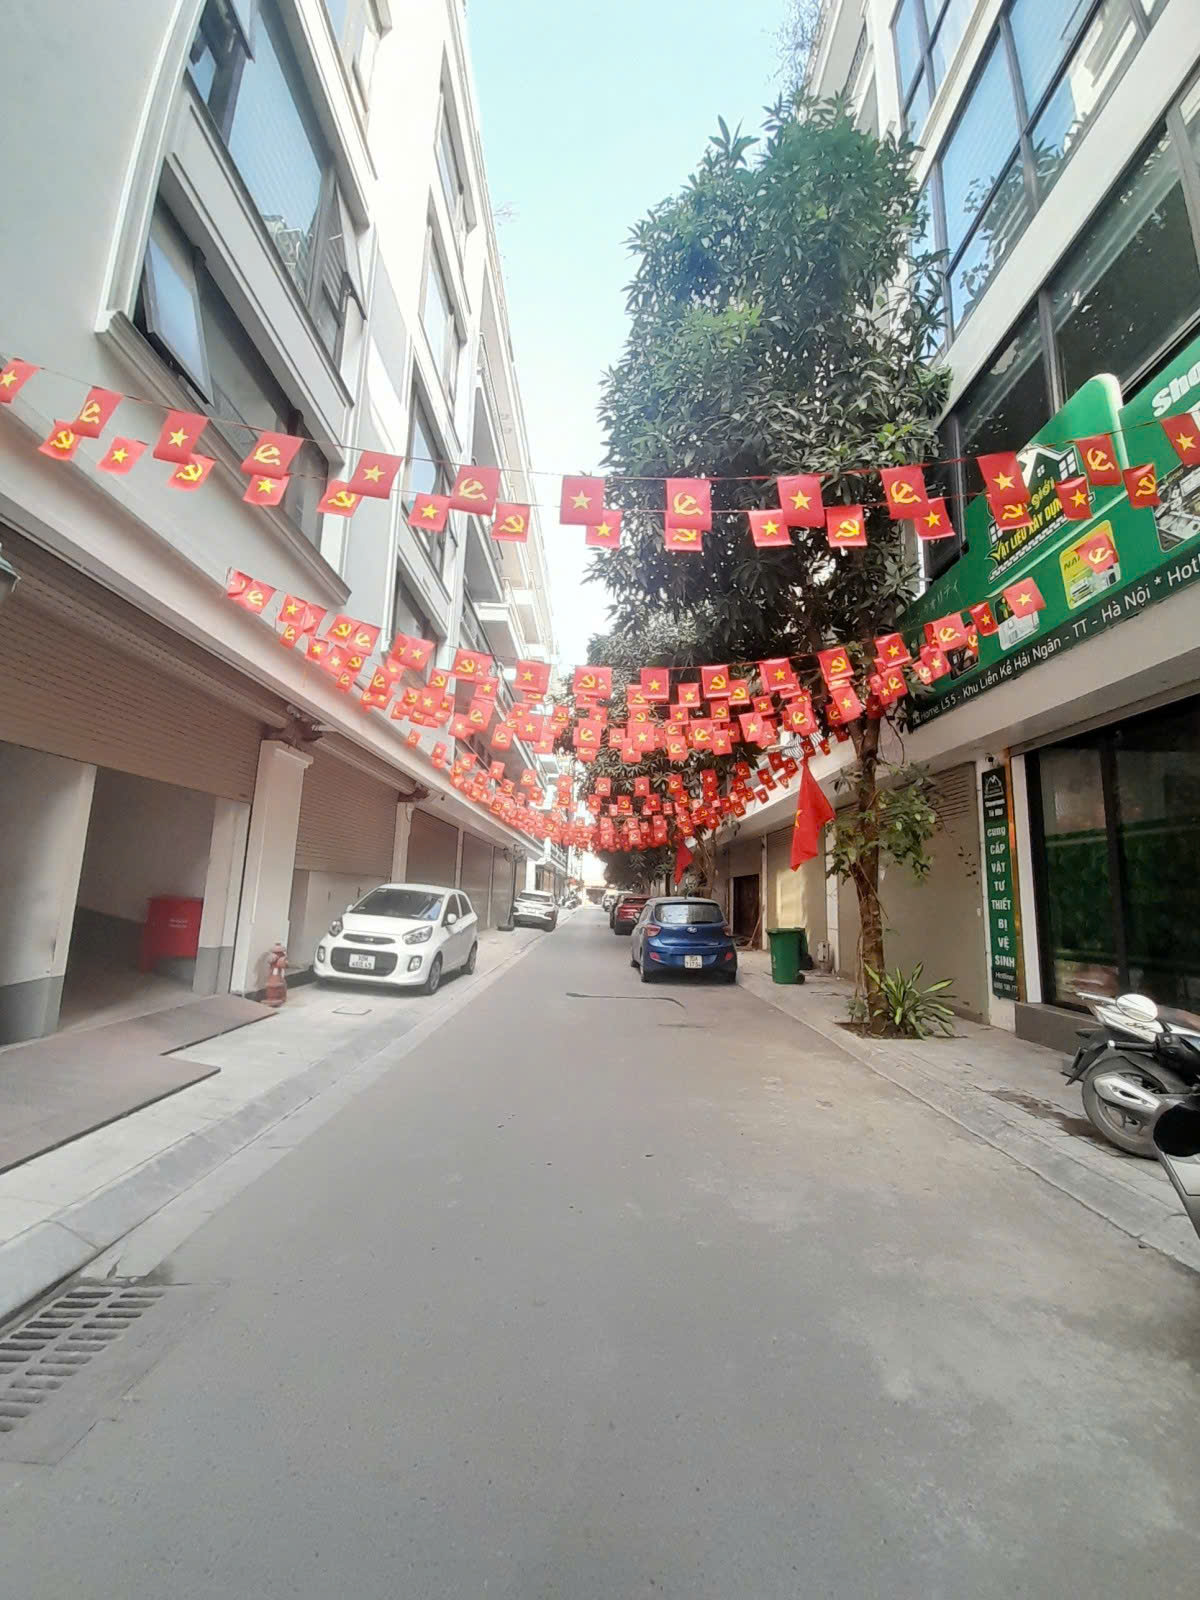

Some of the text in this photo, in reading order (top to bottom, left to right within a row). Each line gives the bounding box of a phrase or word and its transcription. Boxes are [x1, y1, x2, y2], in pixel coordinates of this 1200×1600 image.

[989, 541, 1010, 560] VẬT
[1044, 496, 1063, 521] DỰN
[963, 684, 979, 698] Khu
[1013, 652, 1031, 671] Hải
[1032, 638, 1062, 660] Ngân
[1072, 618, 1088, 638] TT
[1101, 600, 1122, 622] Hà
[1124, 584, 1151, 610] Nội
[991, 861, 1006, 875] VẬT
[993, 880, 1006, 892] TƯ
[991, 897, 1011, 910] THIẾT
[998, 919, 1008, 932] BỊ
[998, 935, 1010, 951] VỆ
[995, 955, 1015, 968] SINH
